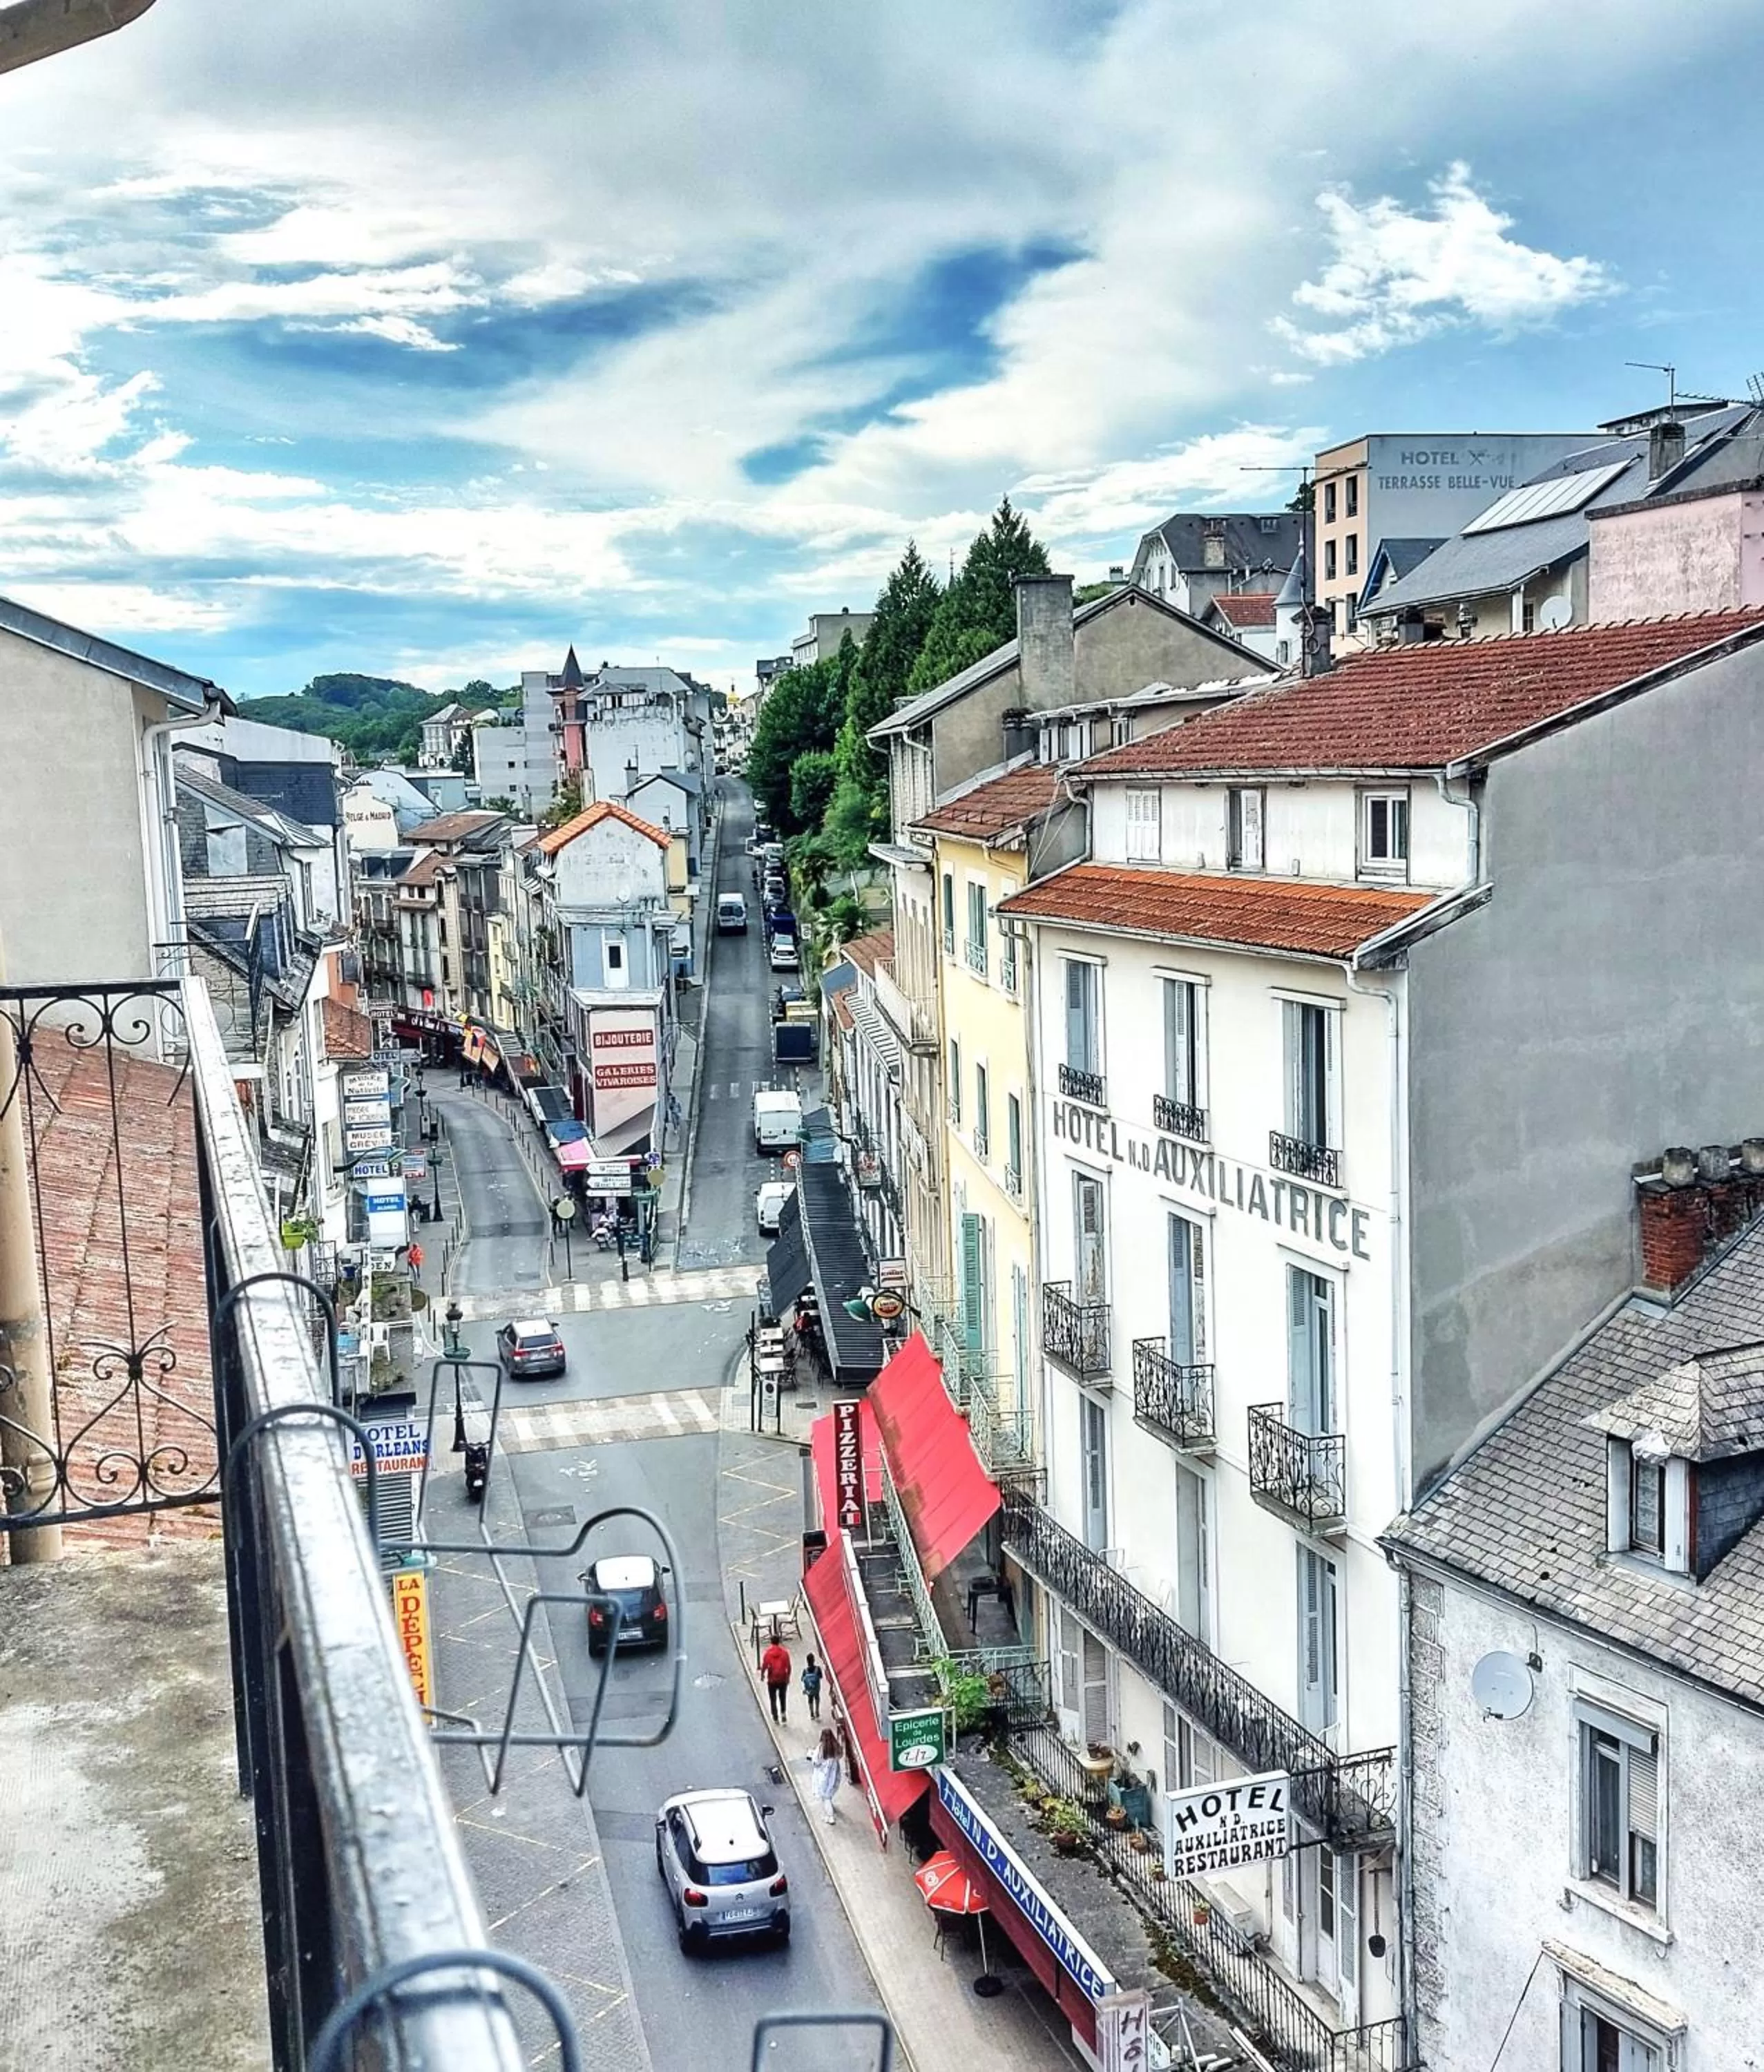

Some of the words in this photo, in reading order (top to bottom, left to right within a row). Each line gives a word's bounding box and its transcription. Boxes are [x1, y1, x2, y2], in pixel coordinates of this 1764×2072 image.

[1401, 451, 1459, 466] HOTEL
[1378, 475, 1441, 490] TERRASSE
[1448, 474, 1515, 490] BELLE-VUE
[595, 1032, 651, 1046] BIJOUTERIE
[596, 1066, 654, 1076] GALERIES
[596, 1076, 656, 1086] VIVAROISES
[354, 1164, 387, 1175] HOTEL
[1053, 1101, 1124, 1162] HOTEL
[1153, 1136, 1371, 1262] AUXILIATRICE
[353, 1439, 429, 1460] DRLEANS
[352, 1456, 430, 1475] RETAURAN
[838, 1405, 859, 1512] PIZZERIA
[398, 1577, 421, 1591] LA
[894, 1716, 939, 1733] Epicerie
[895, 1734, 940, 1749] Lourdes
[1175, 1786, 1284, 1834] HOTEL
[1173, 1818, 1285, 1856] AUXILIATRICE
[1174, 1836, 1286, 1877] RESTAURANT
[1004, 1862, 1102, 1998] AUXILIATRICE
